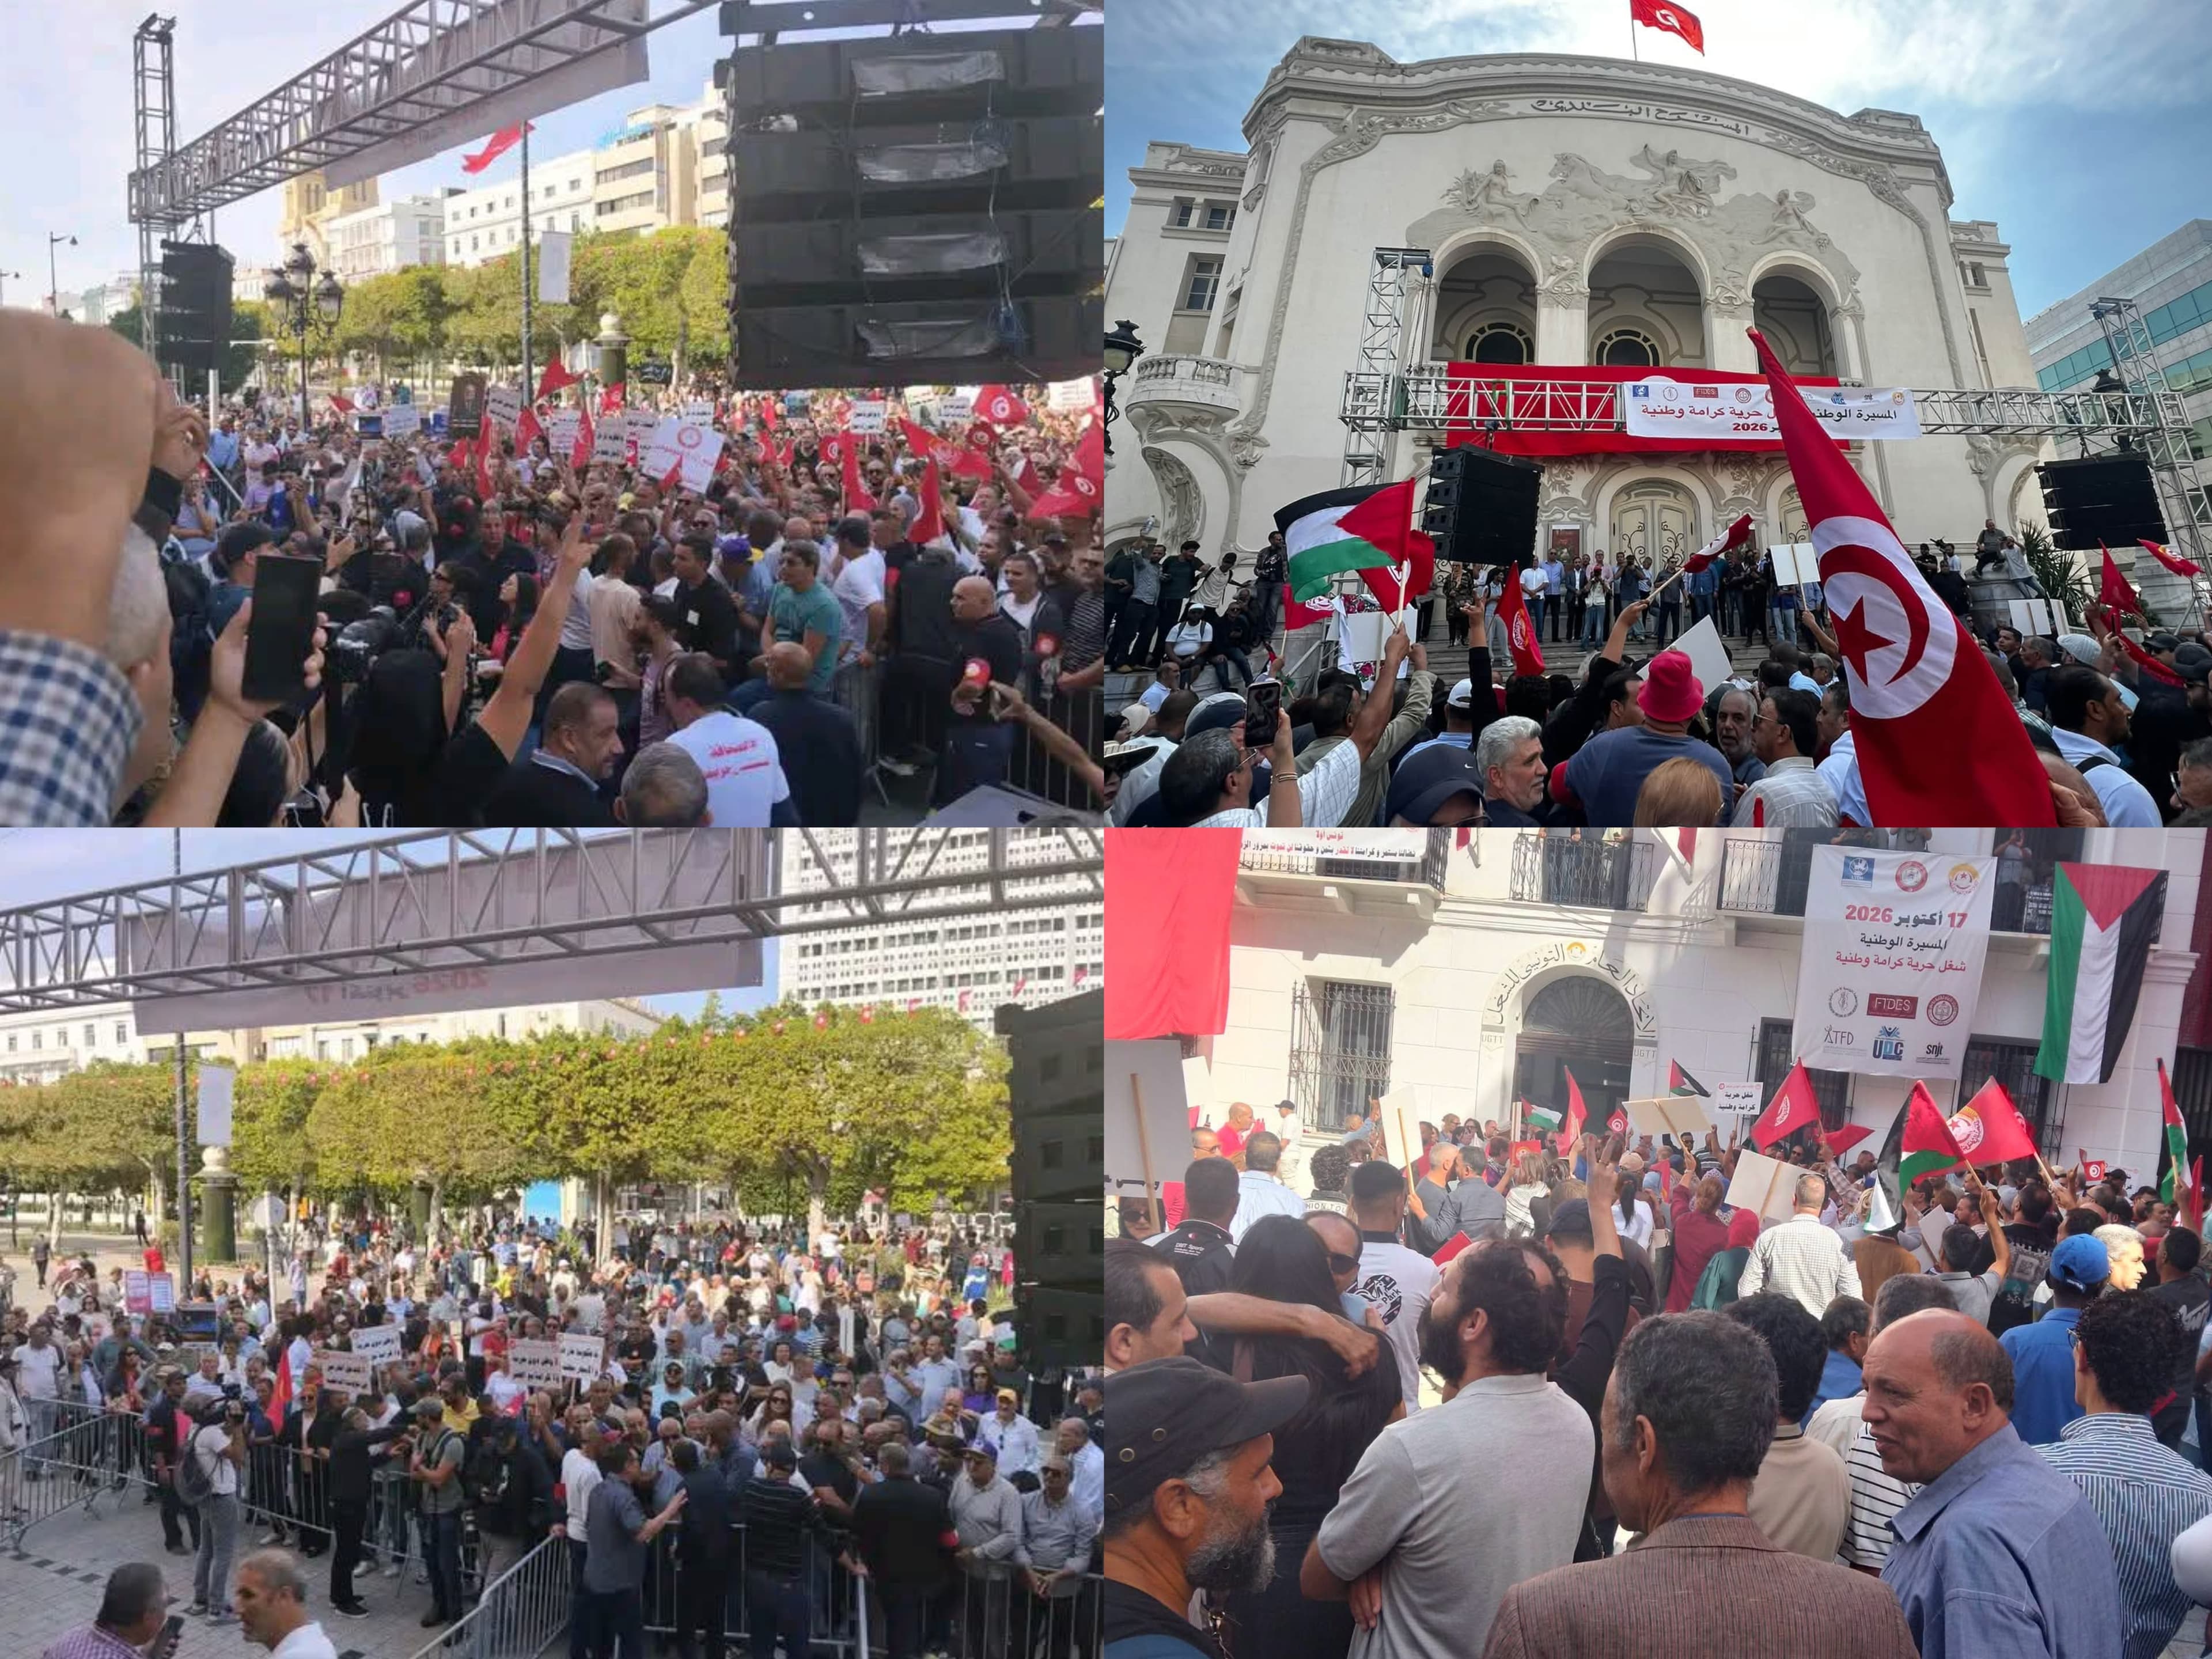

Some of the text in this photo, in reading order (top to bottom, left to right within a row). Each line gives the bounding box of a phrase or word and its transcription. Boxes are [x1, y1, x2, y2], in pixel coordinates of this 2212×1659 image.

[1641, 404, 1684, 419] وطنية
[1688, 406, 1725, 419] كرامة
[1729, 406, 1763, 419] حرية
[1811, 408, 1851, 422] الوطن
[1857, 409, 1897, 422] المسيرة
[1733, 422, 1768, 431] 2026
[1845, 904, 1968, 929] 17 أكتوبر 2026
[1860, 933, 1948, 951] المسيرة الوطنية
[1835, 950, 1967, 973] شغل حرية كرامة وطنية
[1875, 997, 1911, 1012] FTDES
[1482, 1034, 1503, 1044] UGTT
[1634, 1048, 1656, 1059] UGTT
[1926, 1041, 1944, 1058] snjt
[1725, 1091, 1740, 1100] حرية
[1718, 1103, 1756, 1112] كرامة وطنية
[1382, 1289, 1402, 1305] Park
